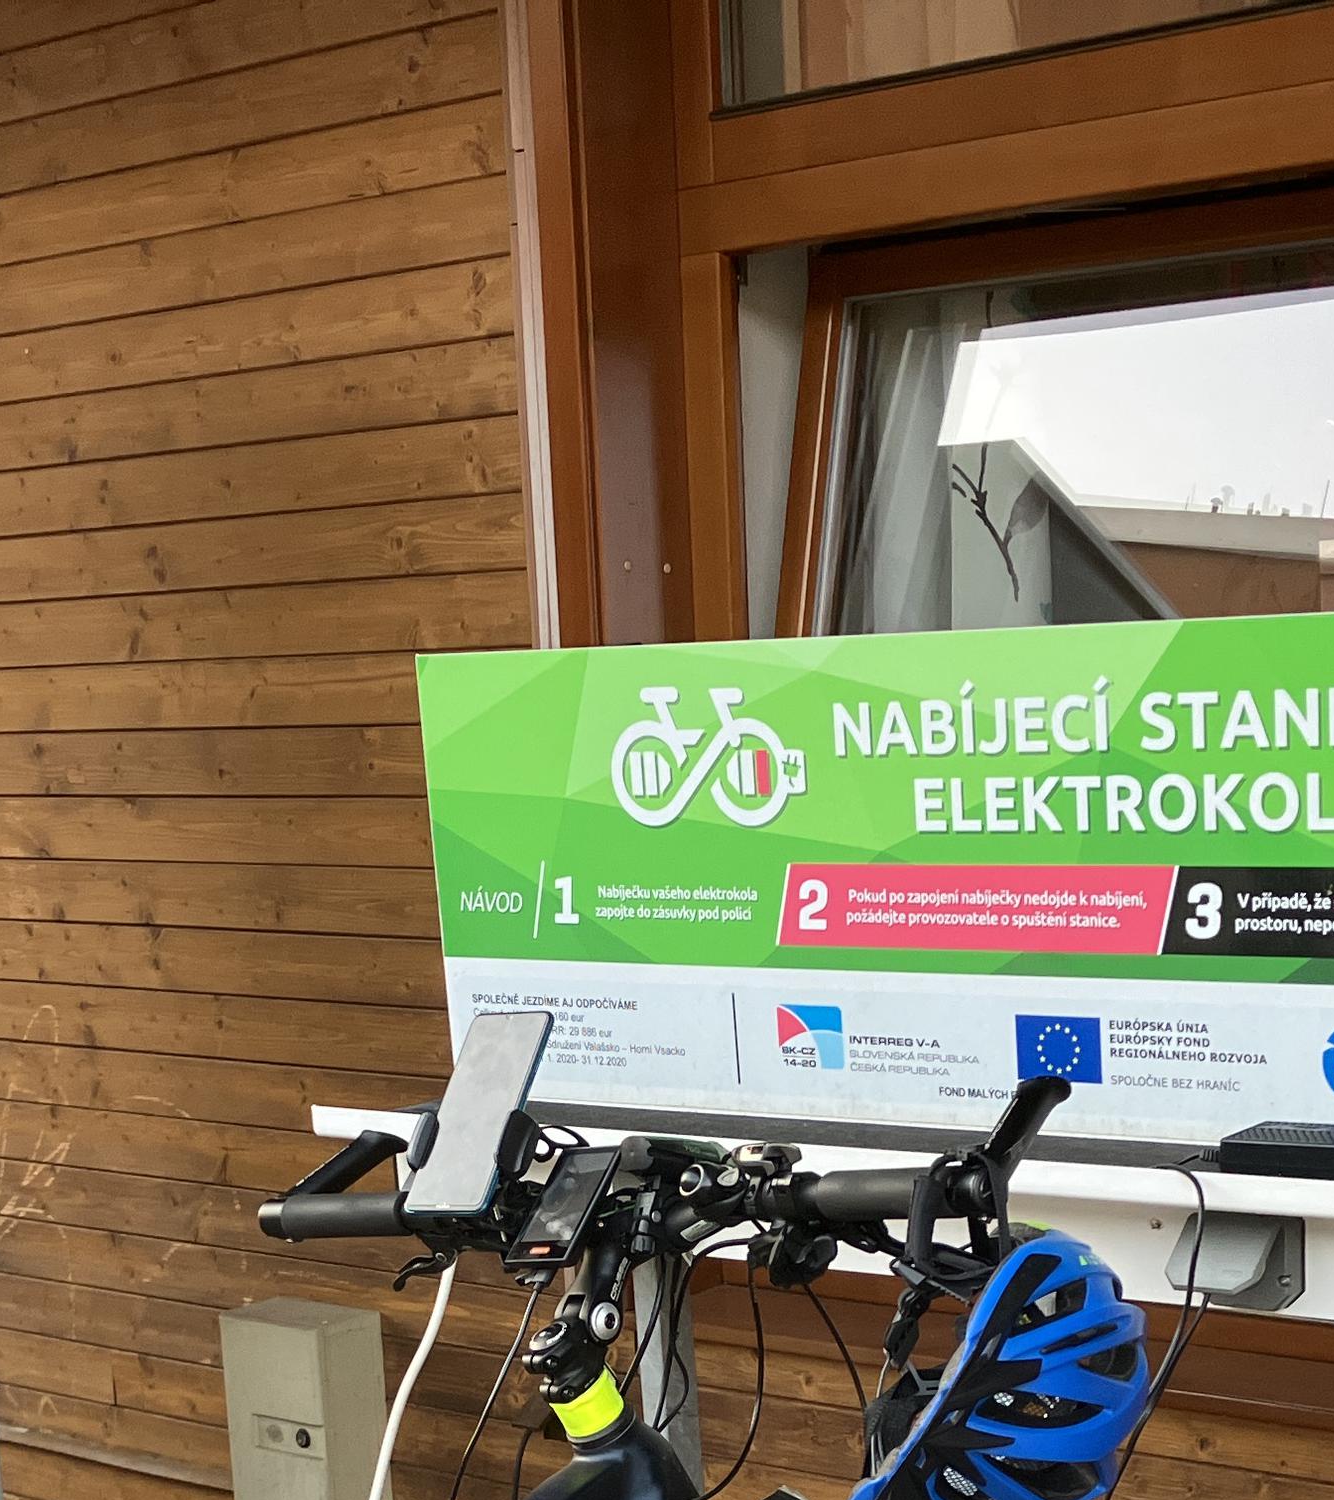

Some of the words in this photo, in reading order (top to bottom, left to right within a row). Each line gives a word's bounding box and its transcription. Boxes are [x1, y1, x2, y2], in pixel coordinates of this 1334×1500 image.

[832, 675, 1110, 757] NABÍJECÍ
[460, 885, 523, 914] NÁVOD
[554, 876, 580, 925] 1
[597, 885, 651, 902] Nabíječku
[652, 886, 691, 901] vašeho
[693, 887, 758, 902] elektrokola
[848, 888, 887, 904] Pokud
[889, 892, 905, 906] po
[907, 889, 959, 907] zapojení
[961, 889, 1022, 909] nabíječky
[1024, 891, 1077, 910] nedojde
[1080, 893, 1088, 906] k
[1090, 892, 1148, 910] nabíjení,
[1237, 893, 1249, 909] V
[1252, 892, 1311, 913] případě,
[1313, 892, 1331, 911] že
[595, 906, 635, 920] zapojte
[637, 906, 651, 919] do
[653, 905, 696, 922] zásuvky
[698, 907, 720, 922] pod
[798, 879, 828, 931] 2
[1185, 882, 1223, 940] 3
[846, 910, 906, 927] požádejte
[908, 911, 999, 927] provozovatele
[1001, 916, 1010, 926] o
[1012, 912, 1067, 930] spuštění
[1069, 914, 1120, 929] stanice.
[1234, 917, 1302, 935] prostoru,
[521, 994, 560, 1007] JEZDÍME
[562, 998, 574, 1008] AJ
[575, 996, 638, 1011] ODPOČÍVÁME
[599, 1029, 613, 1038] eur
[1109, 1019, 1173, 1033] EURÓPSKA
[1176, 1019, 1209, 1034] ÚNIA
[849, 1035, 914, 1048] INTERREG
[916, 1037, 941, 1049] V-A
[1109, 1033, 1173, 1047] EURÓPSKY
[1177, 1036, 1211, 1048] FOND
[849, 1049, 915, 1062] SLOVENSKÁ
[917, 1053, 980, 1065] REPUBLIKA
[1109, 1047, 1206, 1063] REGIONÁLNEHO
[1210, 1053, 1268, 1066] ROZVOJA
[888, 1065, 950, 1077] REPUBLIKA
[1111, 1074, 1169, 1088] SPOLOČNE
[1171, 1078, 1193, 1090] BEZ
[1196, 1078, 1241, 1092] HRANÍC
[939, 1086, 966, 1098] FOND
[967, 1086, 1009, 1100] MALÝCH
